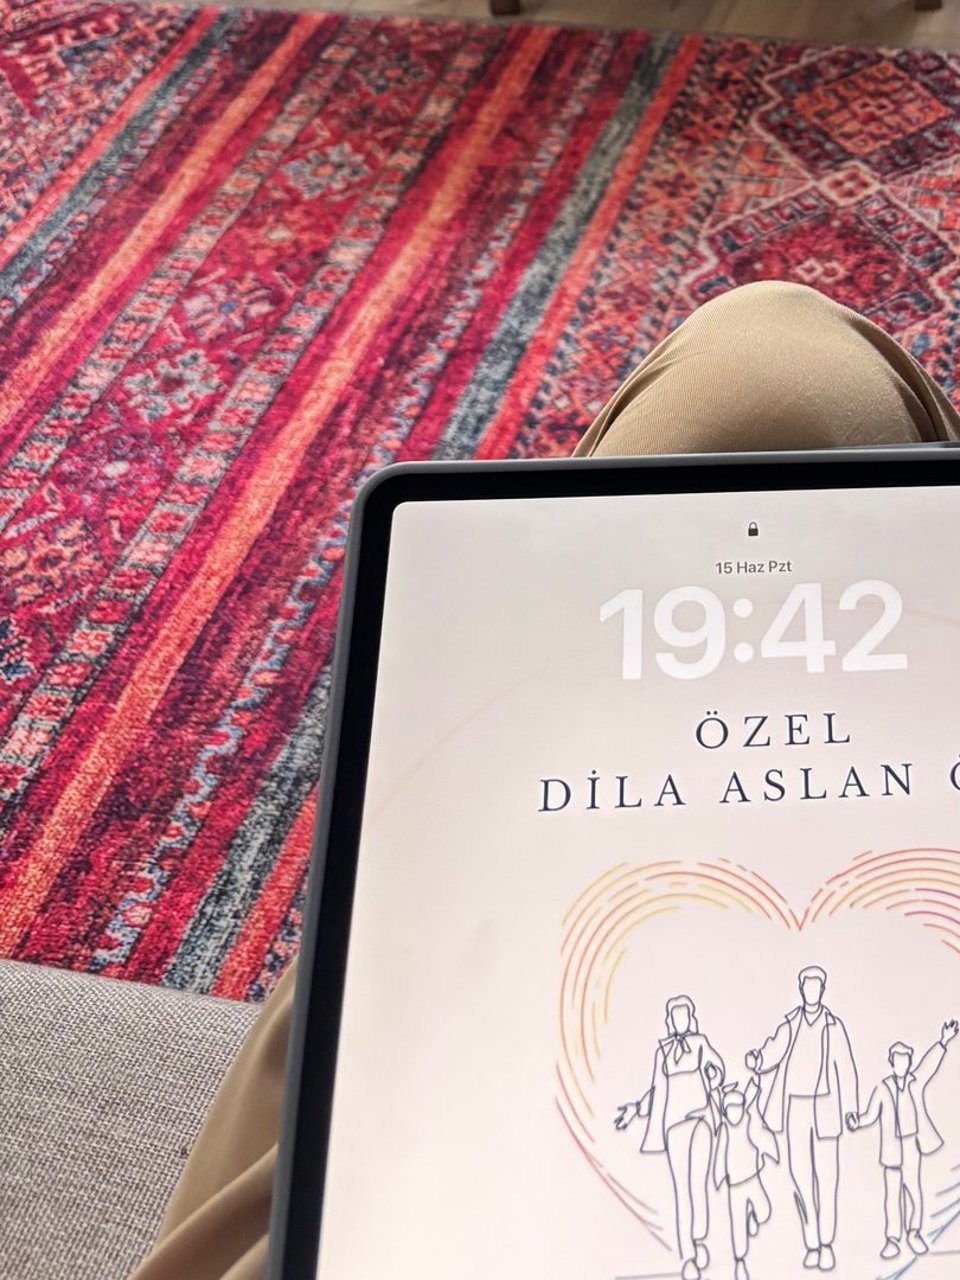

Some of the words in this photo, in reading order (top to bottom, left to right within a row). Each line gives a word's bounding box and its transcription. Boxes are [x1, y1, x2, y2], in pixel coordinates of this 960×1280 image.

[715, 561, 733, 575] 15
[736, 561, 766, 574] Haz
[768, 559, 793, 573] Pzt
[599, 579, 908, 680] 19:42
[695, 710, 852, 749] ÖZEL
[538, 769, 686, 812] DİLA
[719, 763, 914, 804] ASLAN
